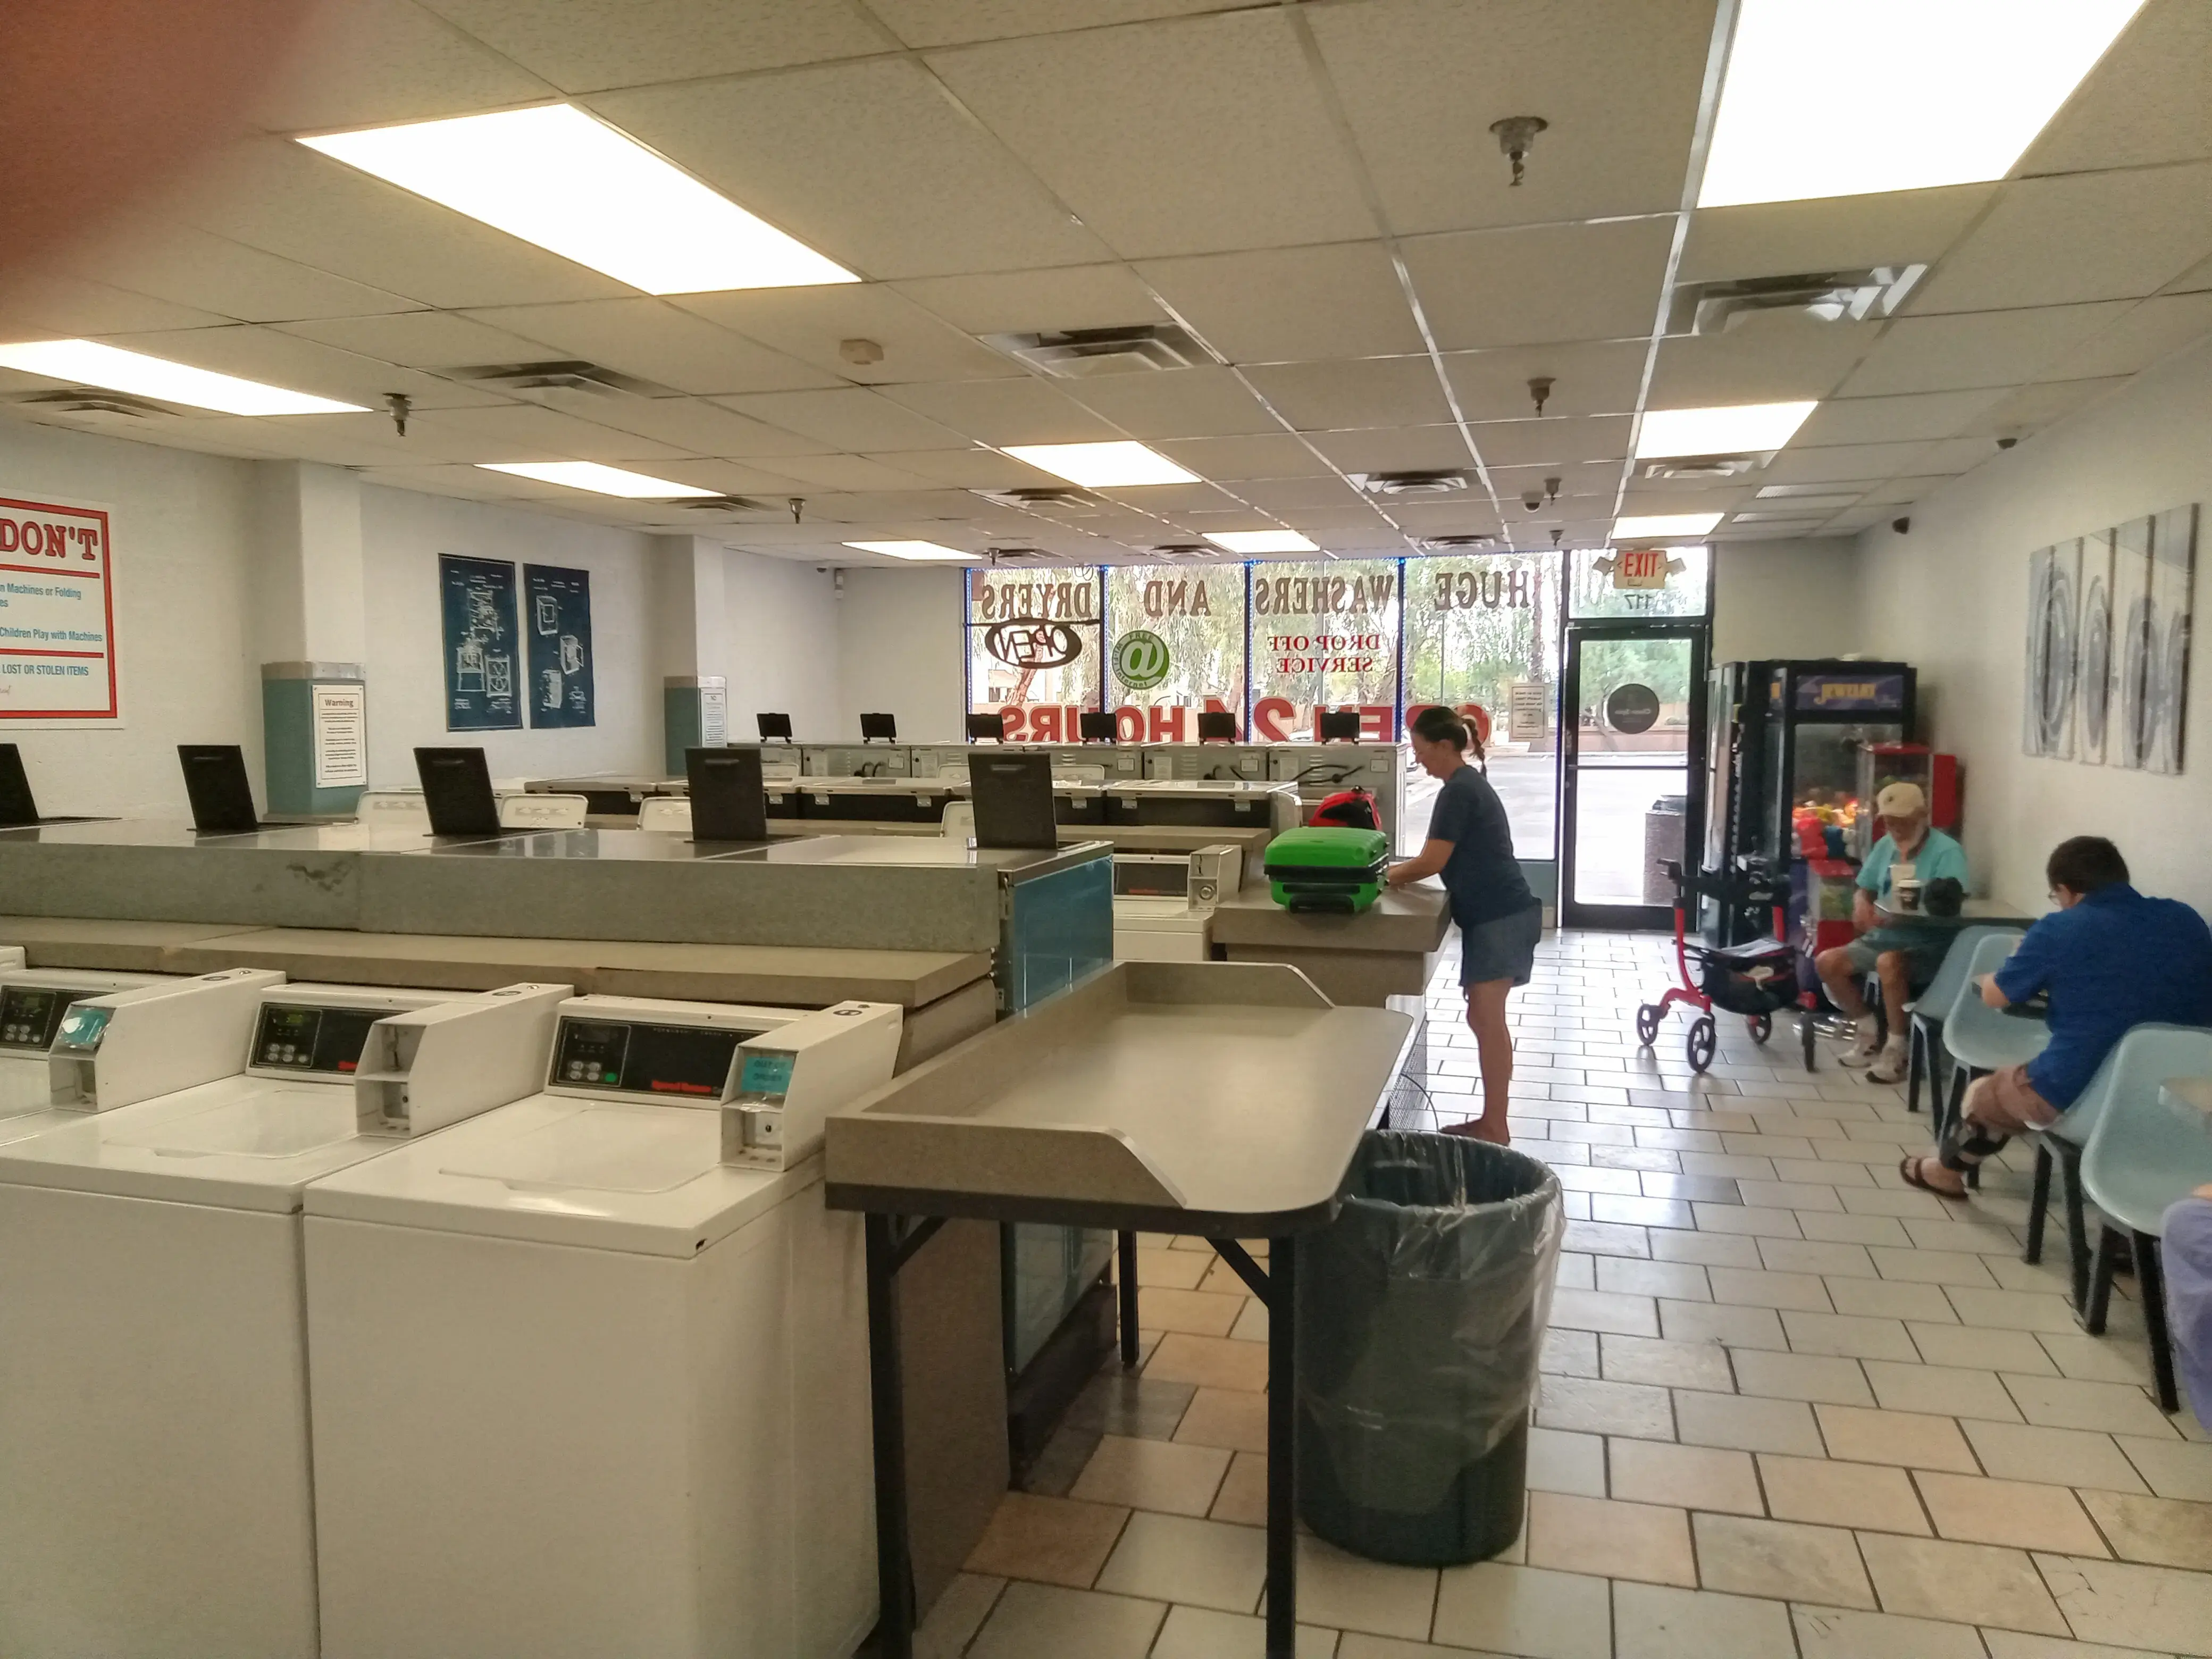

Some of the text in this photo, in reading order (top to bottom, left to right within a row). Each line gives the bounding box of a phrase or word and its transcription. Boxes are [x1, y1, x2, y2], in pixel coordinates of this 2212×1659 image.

[0, 518, 98, 560] DON'T
[1624, 552, 1658, 577] EXIT
[7, 583, 44, 596] Machines
[55, 586, 81, 600] Folding
[0, 626, 103, 642] Children Play with Machines
[2, 664, 89, 676] LOST OR STOLEN ITEMS
[324, 699, 354, 708] Warning
